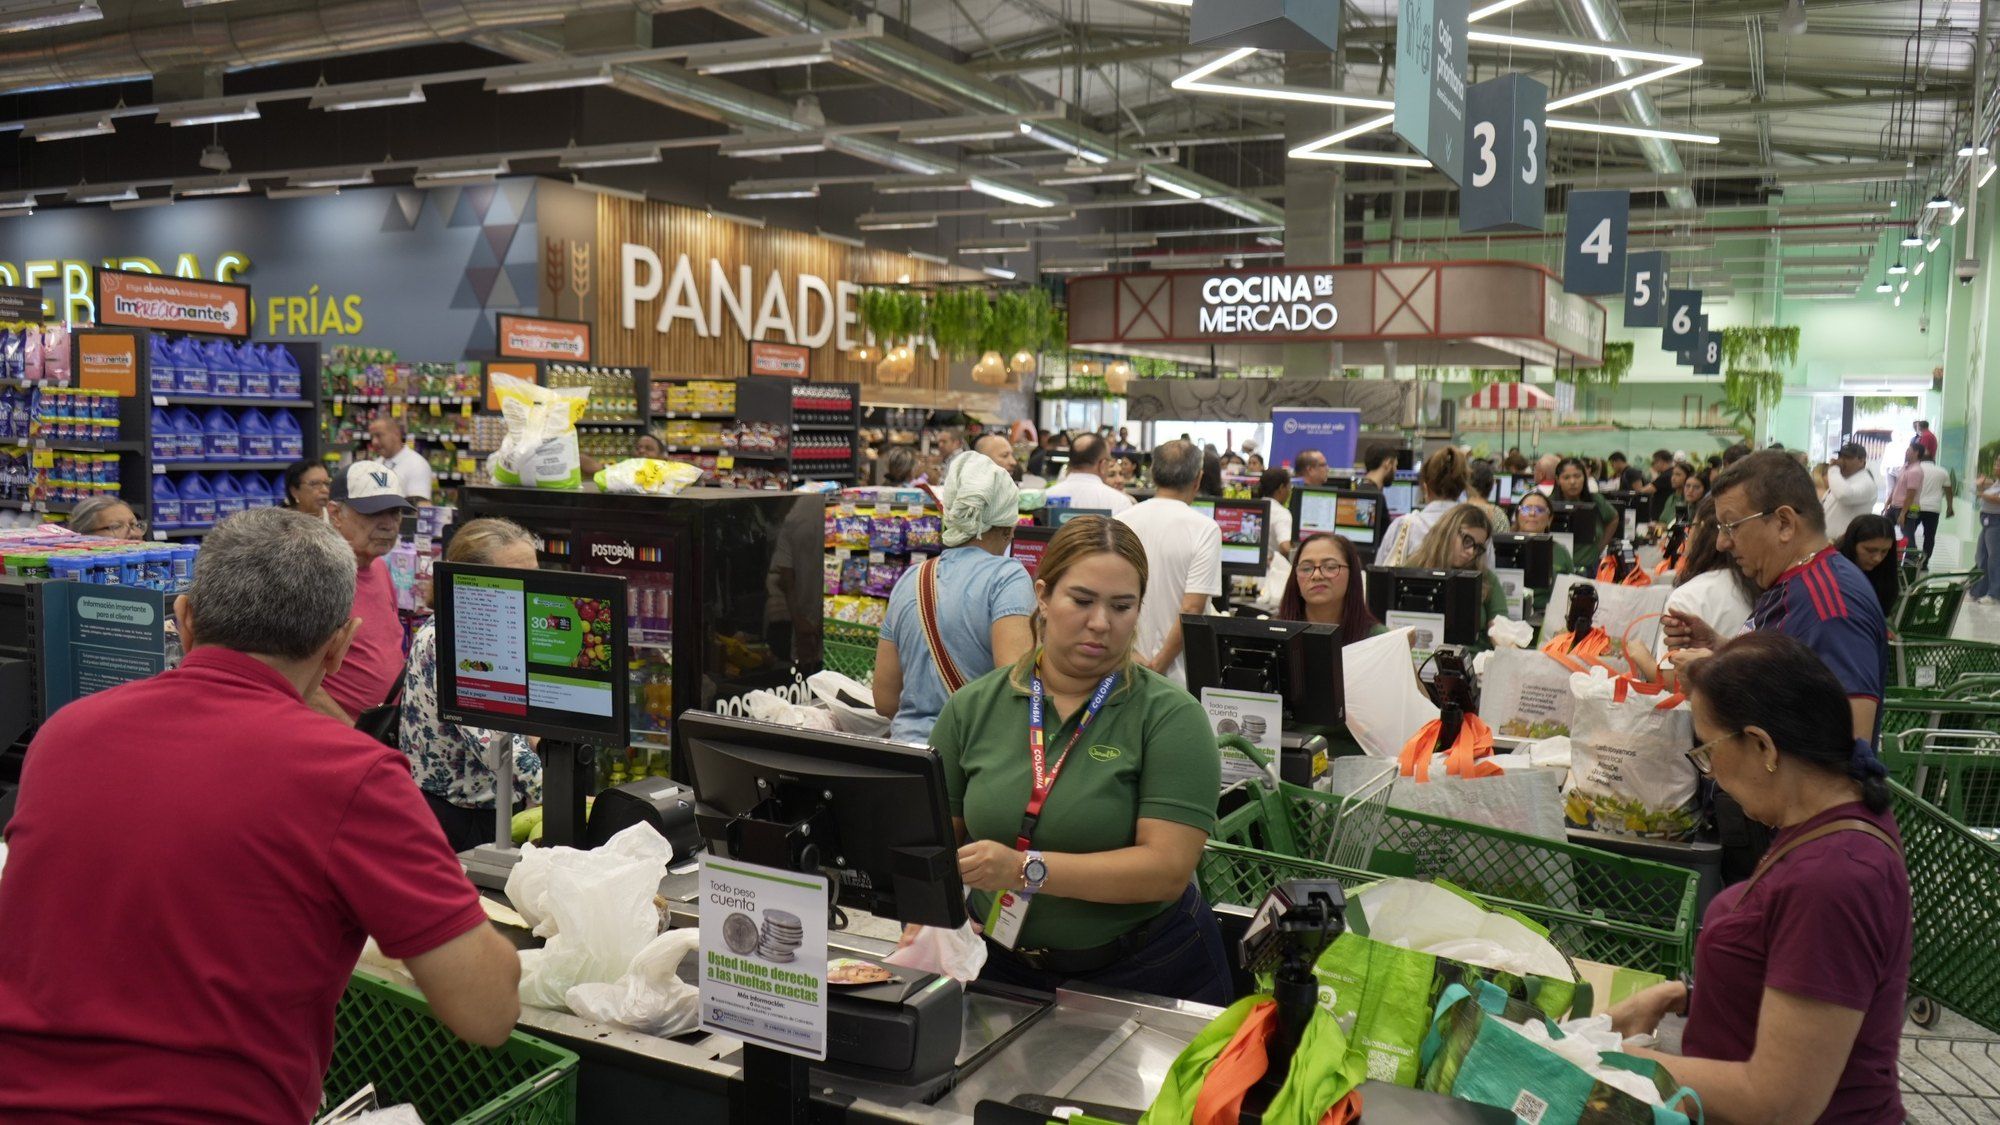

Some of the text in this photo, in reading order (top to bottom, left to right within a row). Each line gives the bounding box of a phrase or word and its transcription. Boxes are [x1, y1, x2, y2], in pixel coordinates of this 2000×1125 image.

[1472, 121, 1497, 188] 3
[1522, 118, 1538, 185] 3
[1580, 217, 1612, 264] 4
[1202, 274, 1333, 305] COCINA DE
[1633, 271, 1651, 307] 5
[268, 284, 364, 336] FRÍAS
[1200, 302, 1338, 333] MERCADO
[1671, 305, 1691, 335] 6
[1706, 341, 1718, 364] 8
[26, 568, 37, 576] 35
[1033, 680, 1041, 723] COLOMBIA
[1209, 708, 1238, 718] cuenta
[443, 714, 463, 722] Lenovo
[710, 880, 756, 899] Todo peso
[710, 893, 755, 912] cuenta
[707, 950, 818, 989] Usted tiene derecho
[707, 966, 818, 1003] a las vueltas exactas
